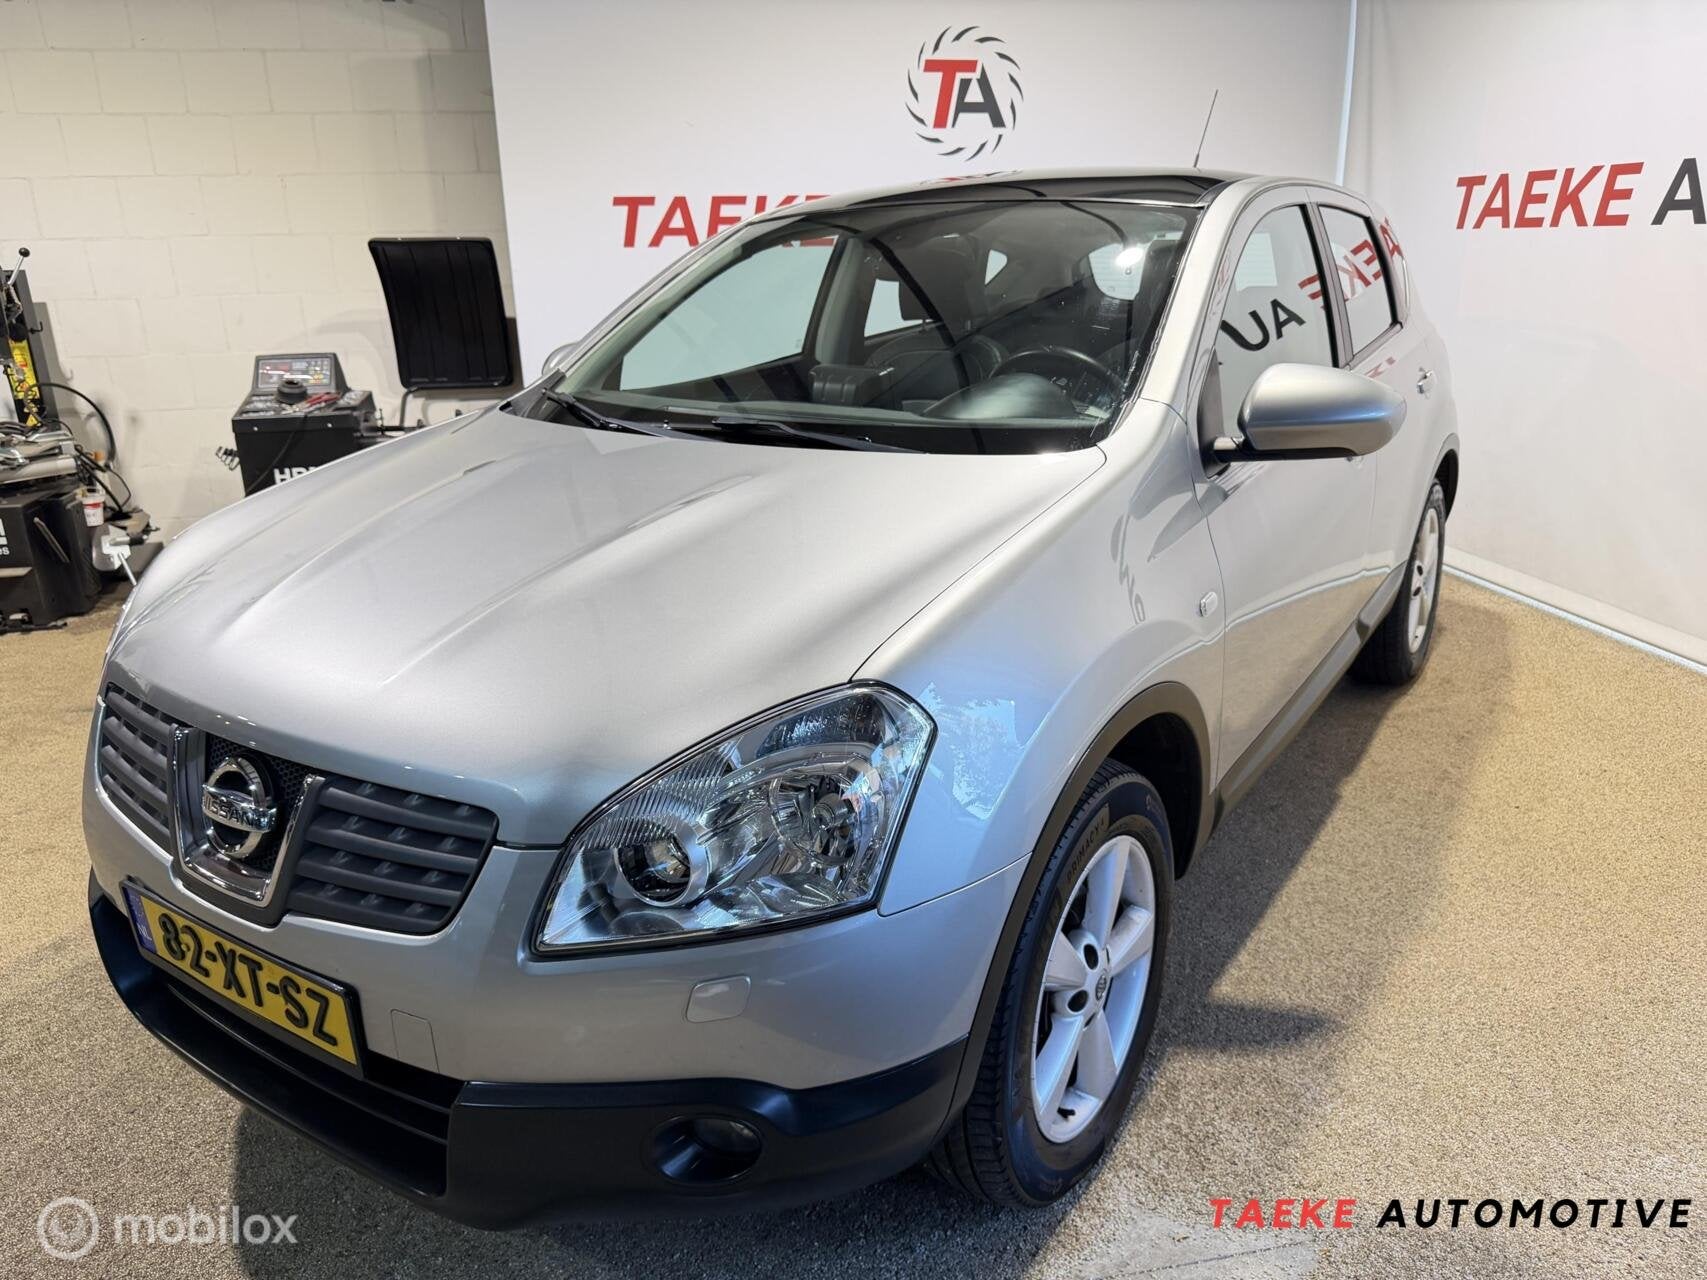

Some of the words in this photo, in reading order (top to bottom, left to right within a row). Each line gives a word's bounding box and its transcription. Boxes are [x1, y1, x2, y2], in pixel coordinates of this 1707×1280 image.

[923, 59, 1007, 130] TA
[1456, 162, 1644, 230] TAEKE
[158, 913, 338, 1046] 82-XT-SZ
